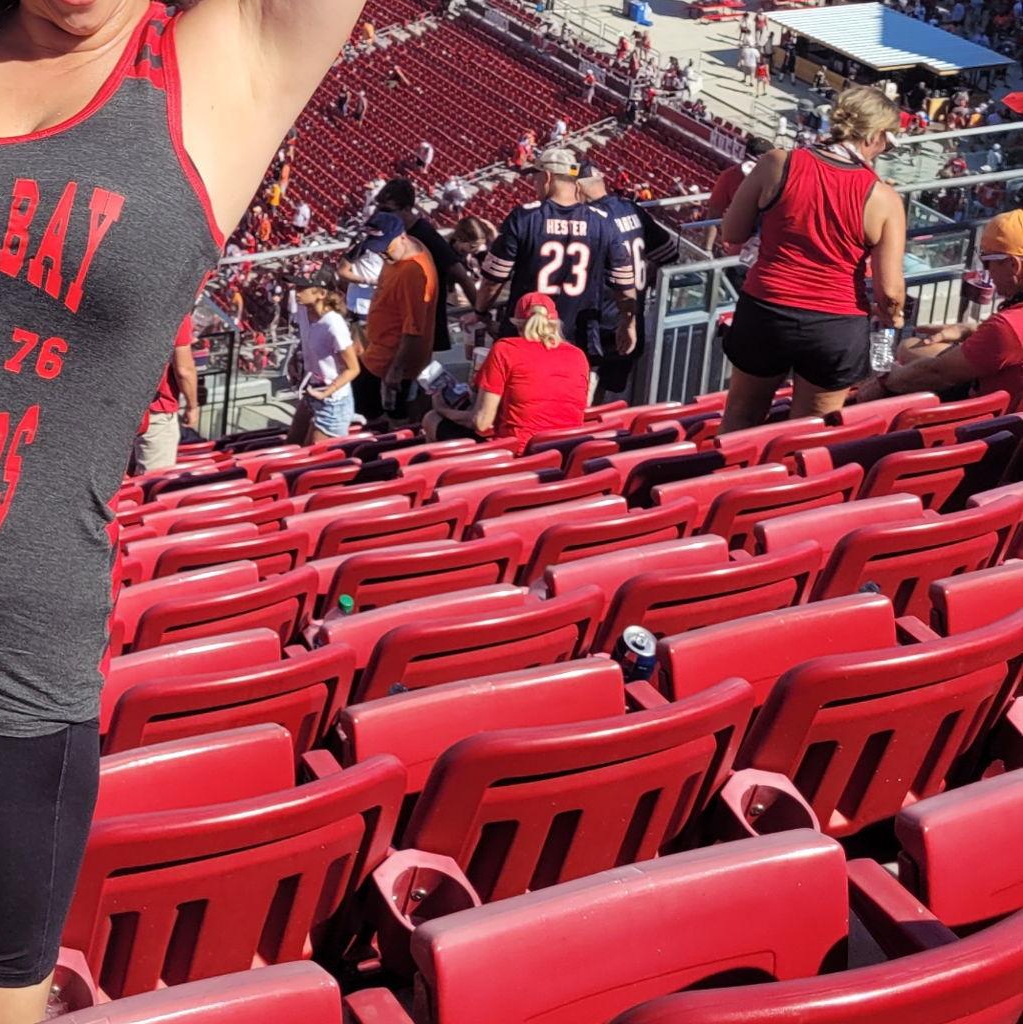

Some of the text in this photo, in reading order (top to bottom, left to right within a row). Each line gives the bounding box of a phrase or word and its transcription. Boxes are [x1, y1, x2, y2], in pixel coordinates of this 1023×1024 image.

[546, 218, 587, 236] HESTER
[537, 240, 590, 296] 23
[5, 327, 69, 380] 76
